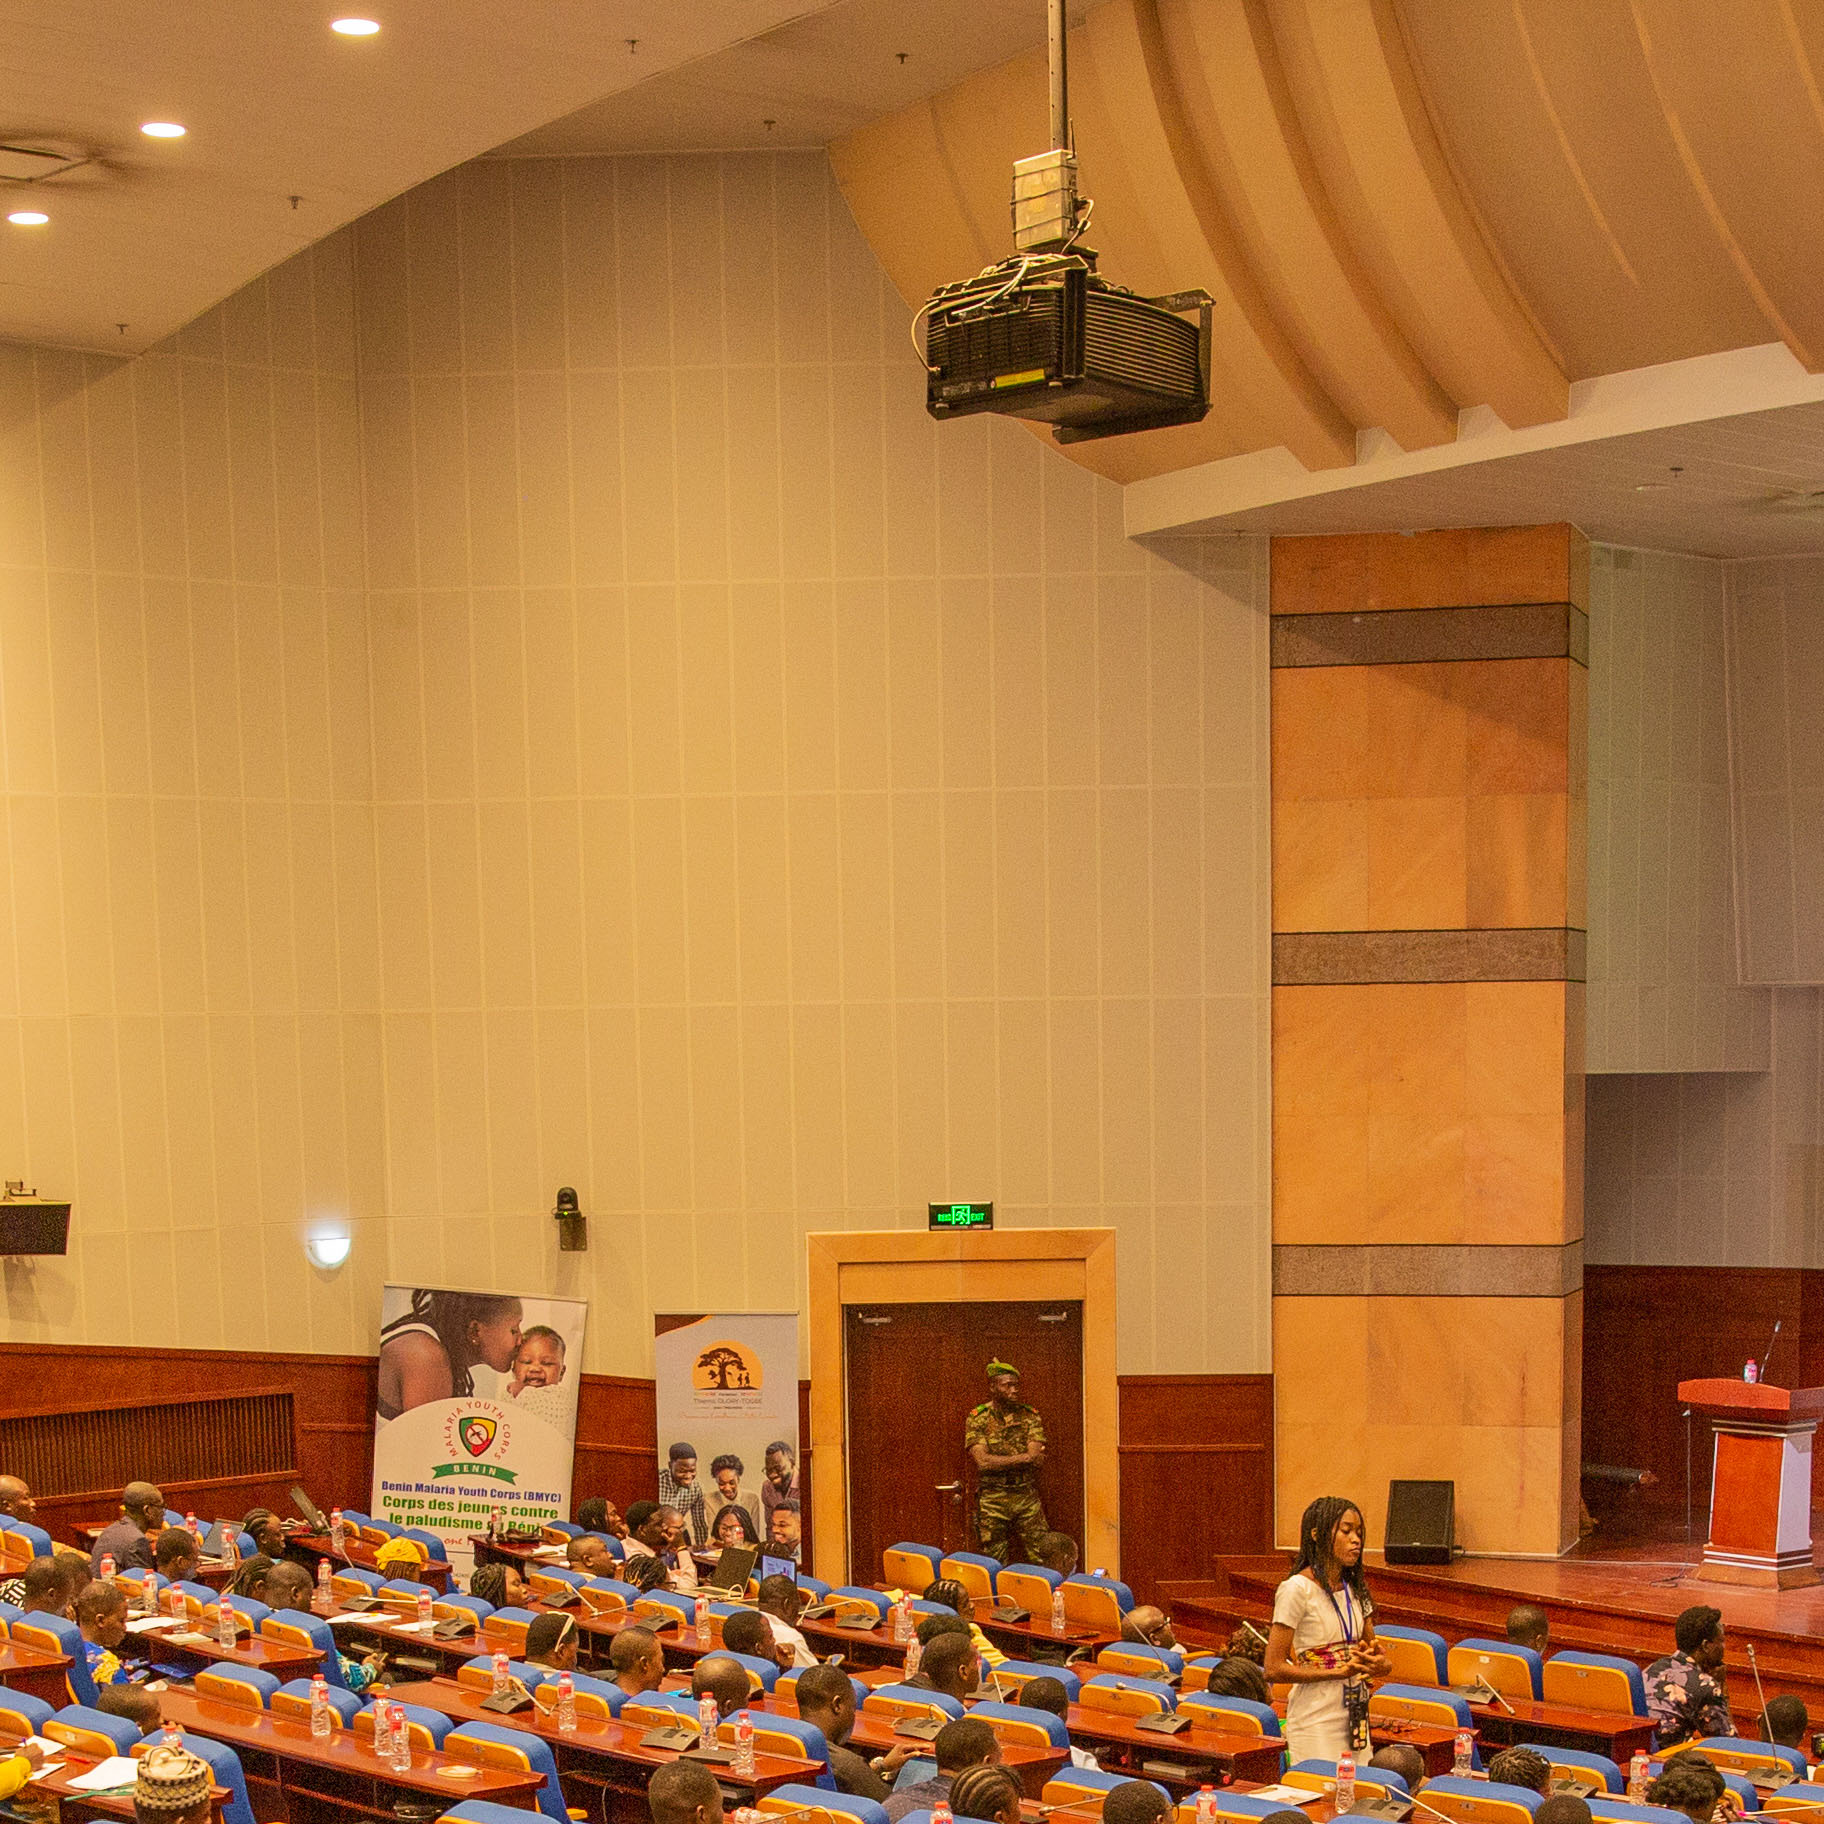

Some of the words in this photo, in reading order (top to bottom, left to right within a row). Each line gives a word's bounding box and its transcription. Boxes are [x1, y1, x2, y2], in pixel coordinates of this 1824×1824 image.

[445, 1407, 463, 1457] MALARIA
[466, 1401, 504, 1419] YOUTH
[494, 1423, 511, 1461] CORPS
[453, 1464, 497, 1476] BENIN
[382, 1480, 412, 1492] Benin
[415, 1483, 455, 1495] Malaria
[458, 1485, 488, 1498] Youth
[490, 1489, 521, 1501] Corps
[524, 1491, 562, 1503] (BMYC)
[383, 1495, 425, 1510] Corps
[428, 1498, 454, 1511] des
[457, 1500, 507, 1515] jeuns
[511, 1506, 558, 1519] contre
[389, 1512, 403, 1525] le
[406, 1514, 482, 1531] paludisme
